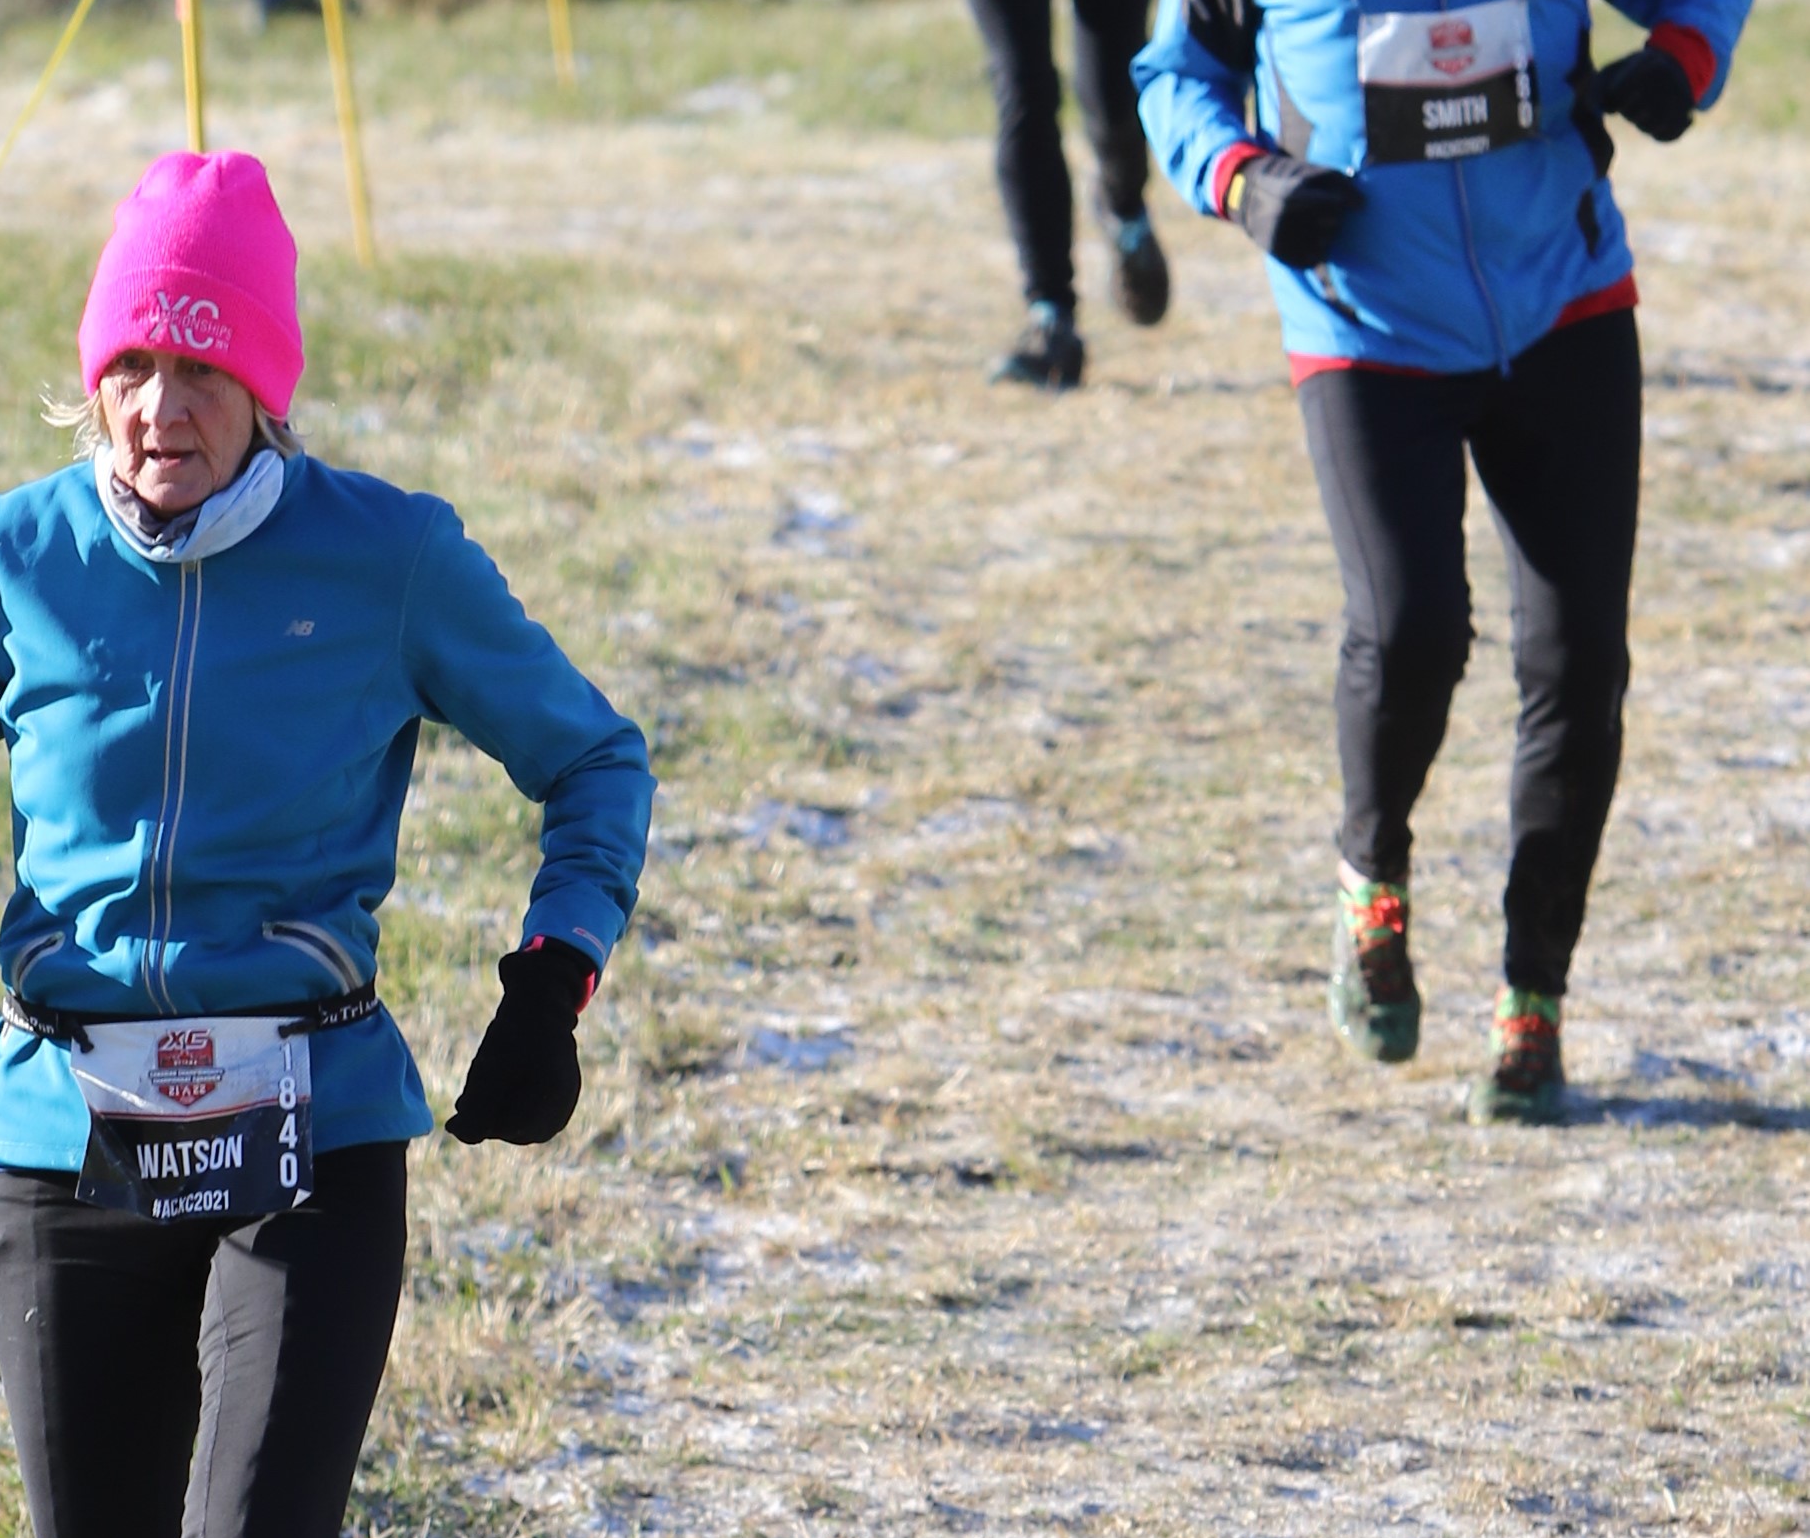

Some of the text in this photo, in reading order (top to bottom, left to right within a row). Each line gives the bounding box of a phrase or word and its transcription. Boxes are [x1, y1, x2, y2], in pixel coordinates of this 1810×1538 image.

[1422, 93, 1488, 129] SMITH
[149, 290, 220, 351] XC
[278, 1041, 298, 1188] 1840
[136, 1133, 243, 1180] WATSON
[152, 1189, 230, 1219] #ACXC2021
